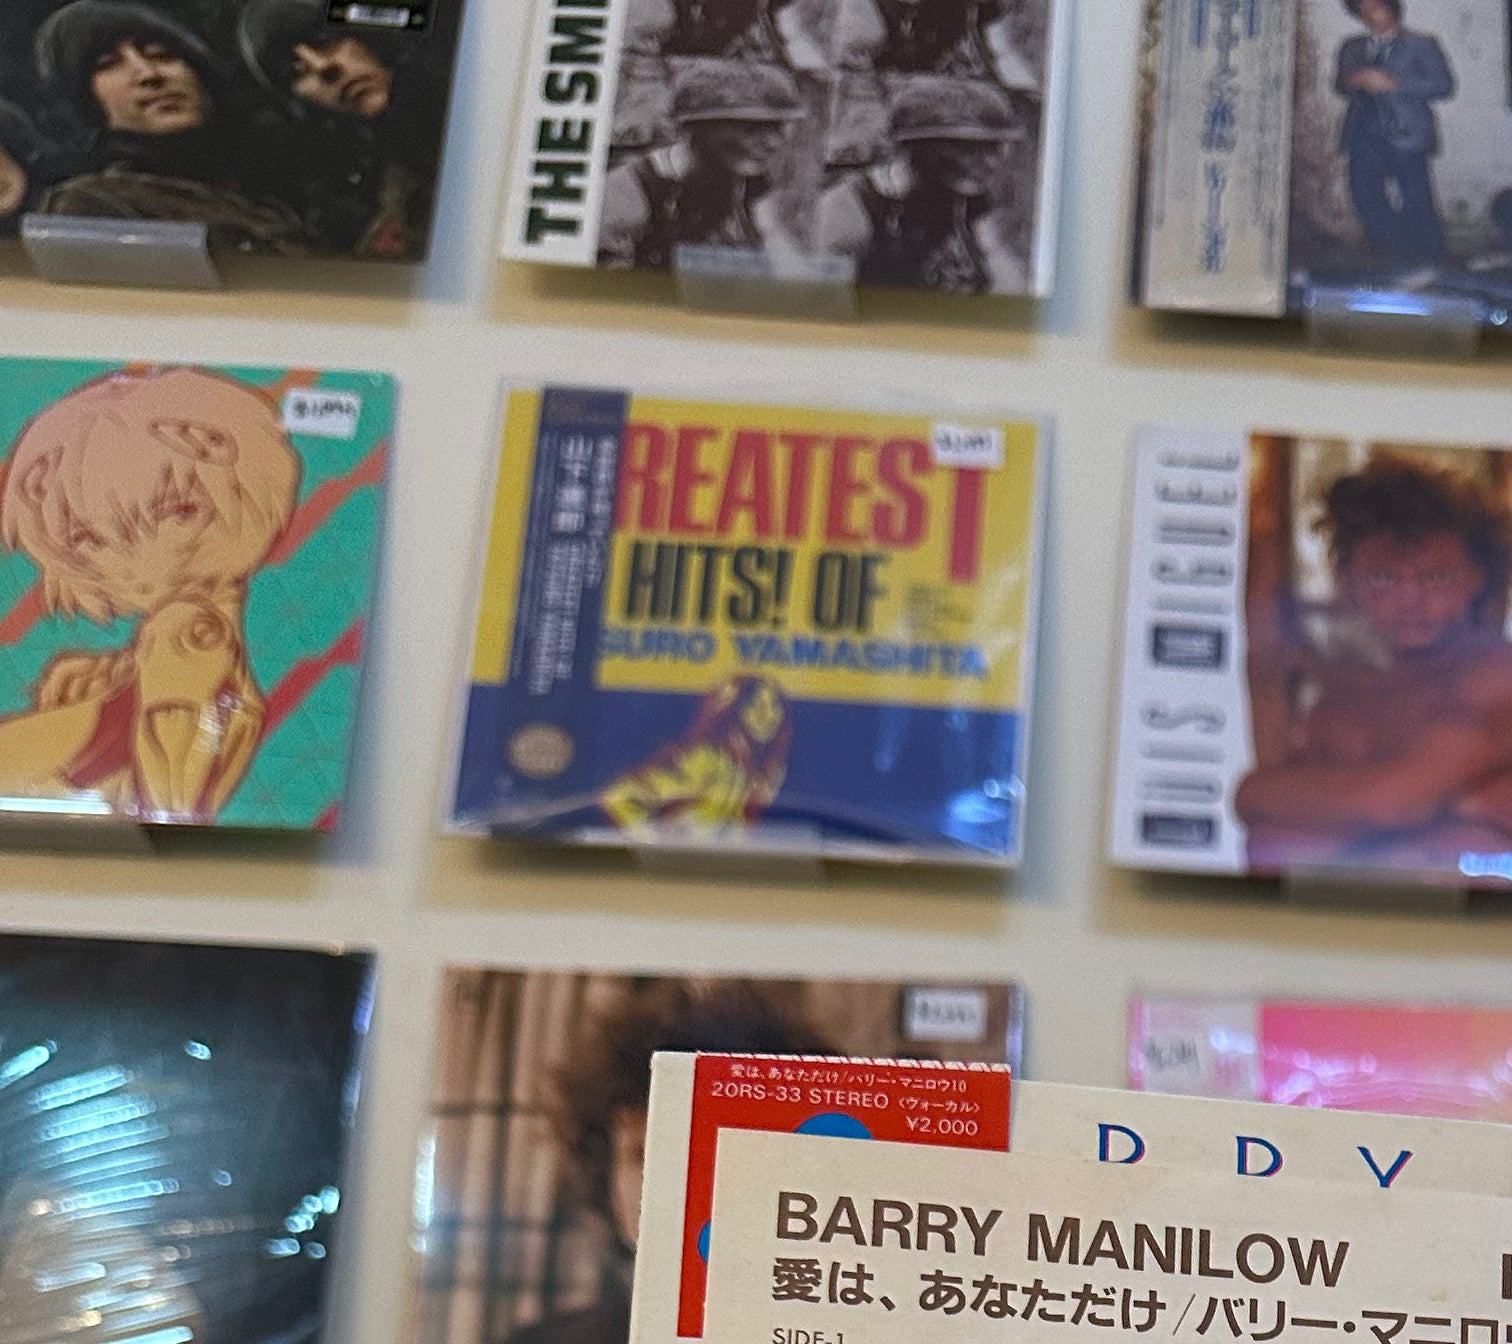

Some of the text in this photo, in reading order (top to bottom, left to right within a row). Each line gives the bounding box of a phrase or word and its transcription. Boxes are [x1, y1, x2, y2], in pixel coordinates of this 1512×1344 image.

[526, 117, 594, 245] THE
[612, 421, 985, 584] REATEST
[811, 549, 894, 633] OF
[711, 1082, 802, 1101] 20RS-33
[809, 1089, 889, 1110] STEREO
[775, 1190, 1350, 1287] BARRY MANILOW
